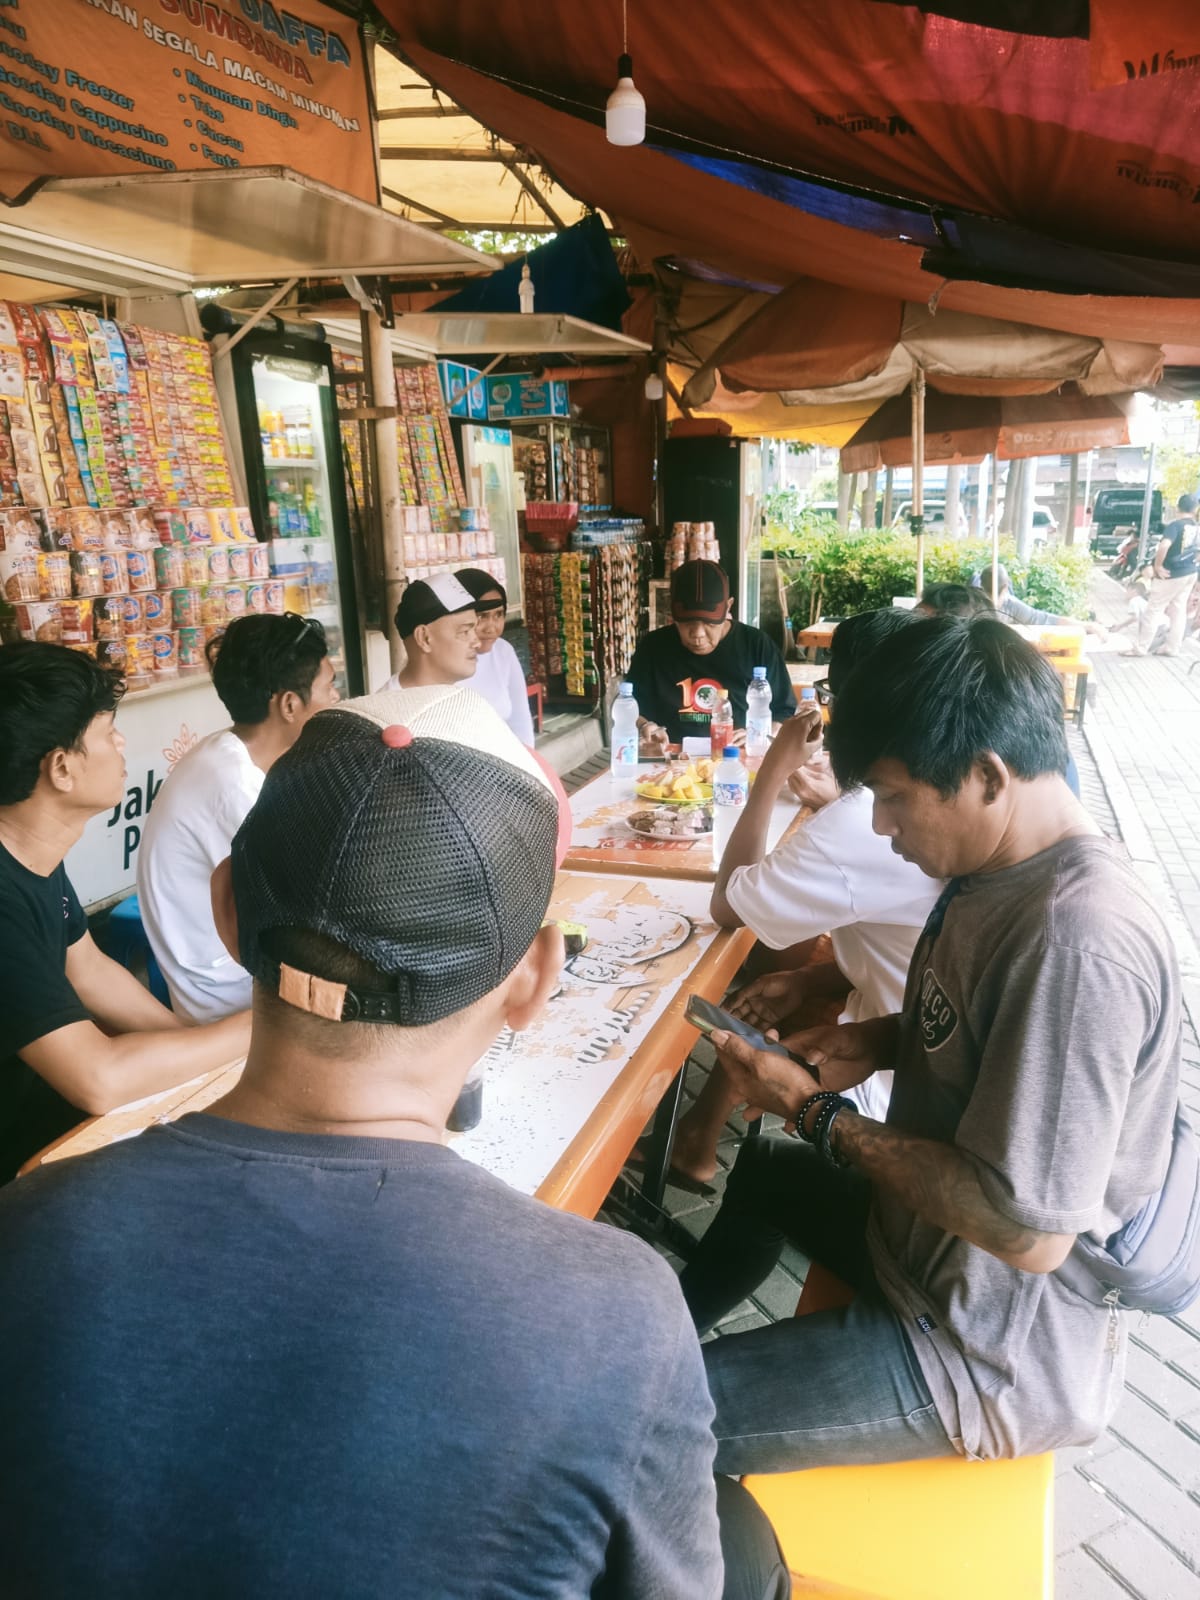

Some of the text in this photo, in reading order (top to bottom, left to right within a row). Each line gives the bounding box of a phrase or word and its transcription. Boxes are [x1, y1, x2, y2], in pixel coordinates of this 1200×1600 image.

[65, 69, 135, 111] Freezer
[142, 17, 219, 71] SEGALA
[223, 57, 289, 101] MACAM
[290, 92, 360, 132] MINUMAN
[184, 68, 253, 112] Minuman
[70, 98, 169, 147] Cappucino
[77, 124, 177, 172] Mocacinno
[107, 769, 163, 827] Jak
[123, 825, 141, 870] P
